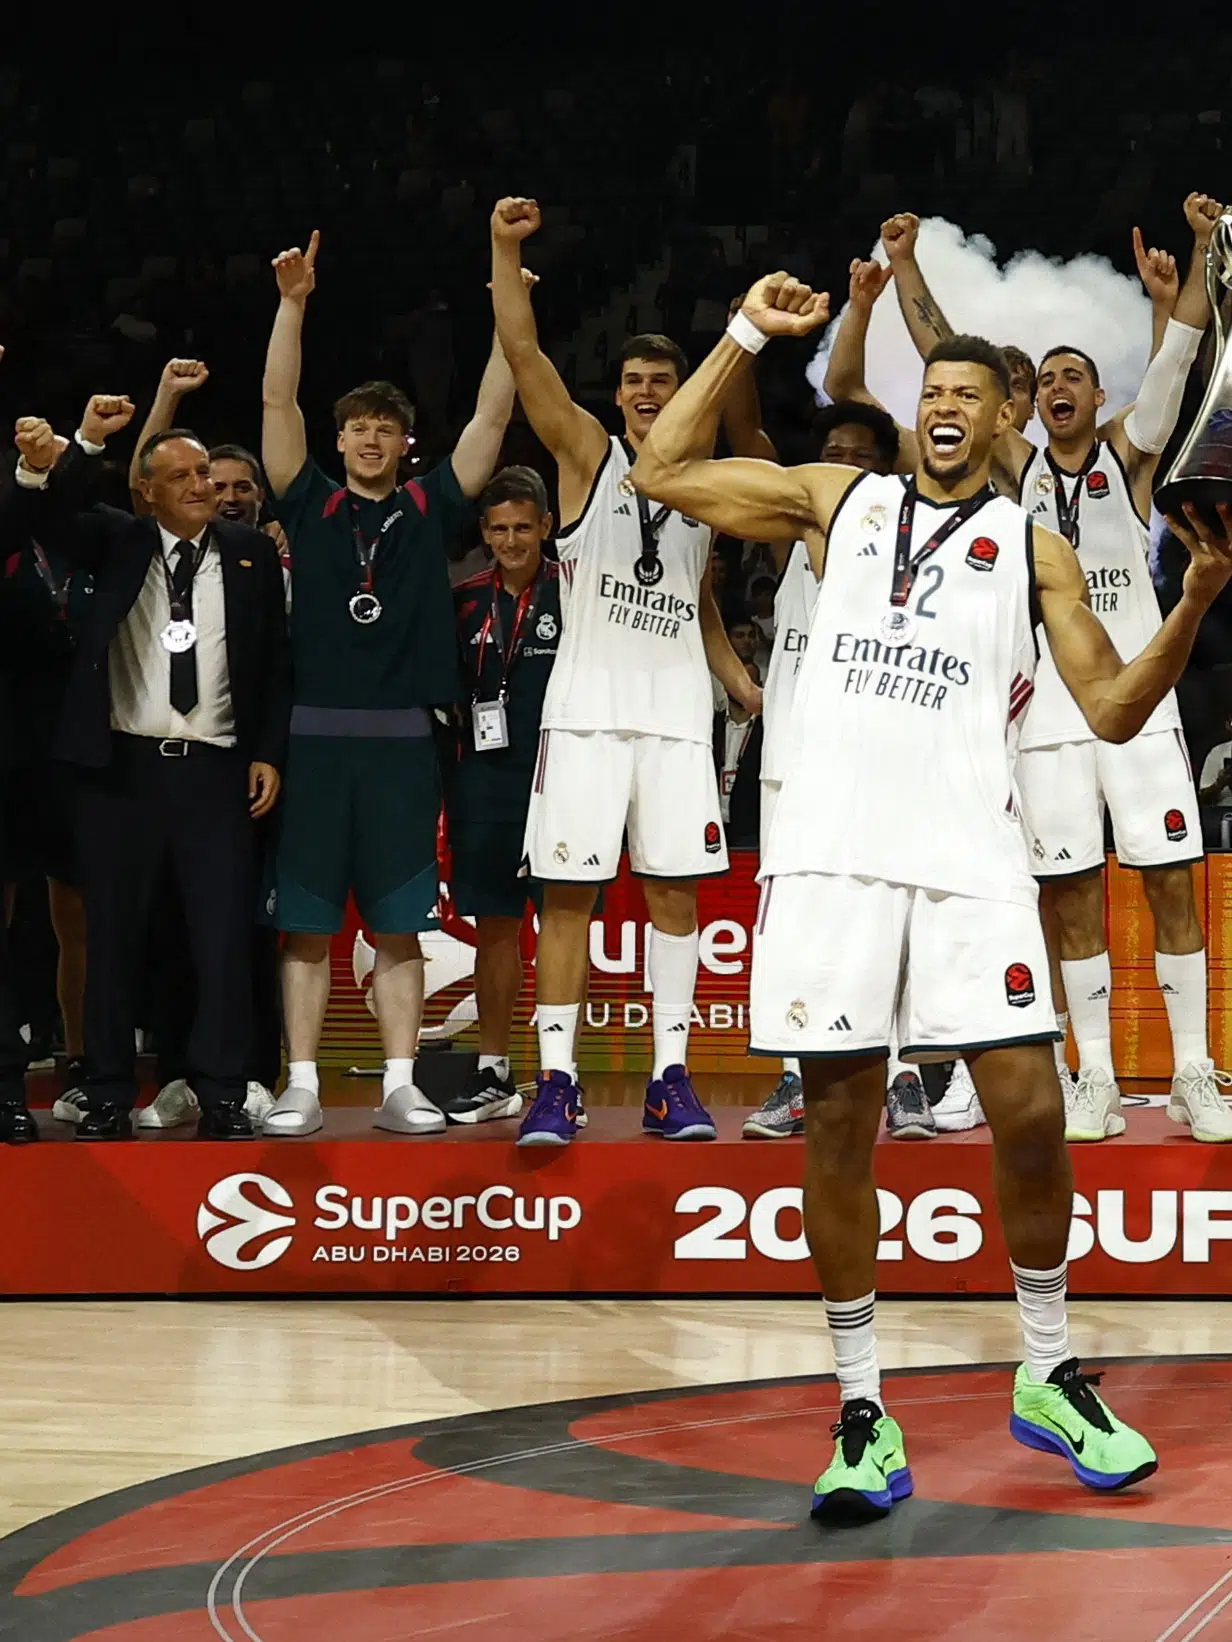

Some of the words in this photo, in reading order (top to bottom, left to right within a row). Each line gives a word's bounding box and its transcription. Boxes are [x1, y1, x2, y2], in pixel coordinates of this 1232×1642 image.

[1086, 566, 1132, 589] ates
[600, 573, 697, 622] Emirates
[1091, 592, 1119, 612] TER
[608, 603, 630, 626] FLY
[631, 610, 681, 640] BETTER
[844, 668, 874, 695] FLY
[874, 671, 948, 711] BETTER
[624, 1001, 744, 1029] DABI
[313, 1184, 582, 1241] SuperCup
[312, 1245, 366, 1263] ABU
[372, 1245, 451, 1263] DHABI
[456, 1245, 521, 1263] 2026
